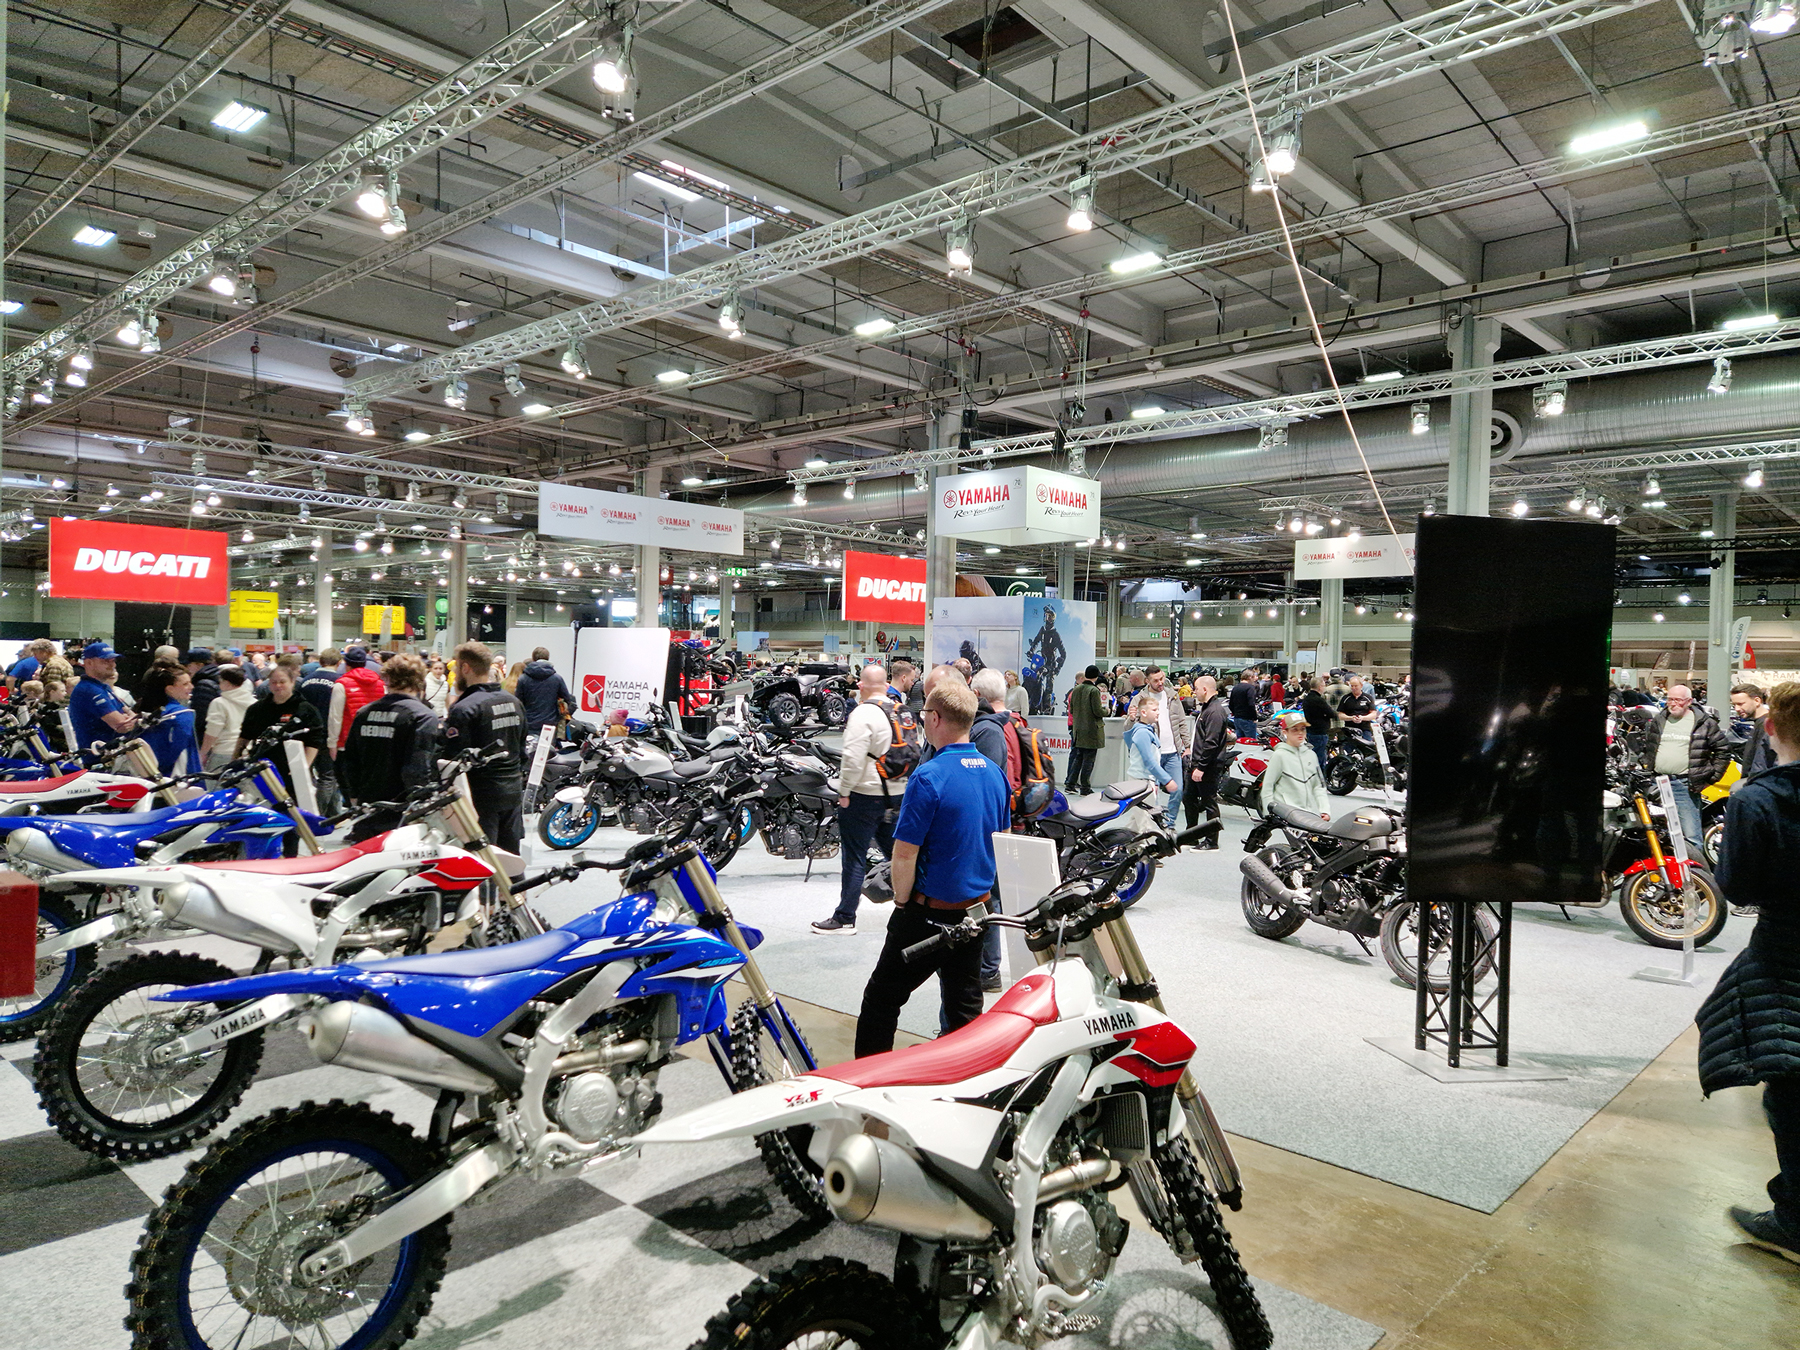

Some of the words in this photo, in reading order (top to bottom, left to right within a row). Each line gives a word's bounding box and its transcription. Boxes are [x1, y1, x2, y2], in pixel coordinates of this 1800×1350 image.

[958, 484, 1010, 506] YAMAHA
[1048, 486, 1088, 510] YAMAHA
[558, 503, 588, 515] YAMAHA
[608, 510, 637, 521] YAMAHA
[665, 517, 690, 528] YAMAHA
[708, 522, 732, 532] YAMAHA
[74, 548, 211, 578] DUCATI
[418, 616, 446, 626] SLT
[607, 680, 649, 690] YAMAHA
[606, 691, 640, 700] MOTOR
[604, 702, 651, 712] ACADEMY
[400, 850, 440, 860] YAMAHA
[210, 1008, 266, 1040] YAMAHA
[1084, 1012, 1136, 1035] YAMAHA
